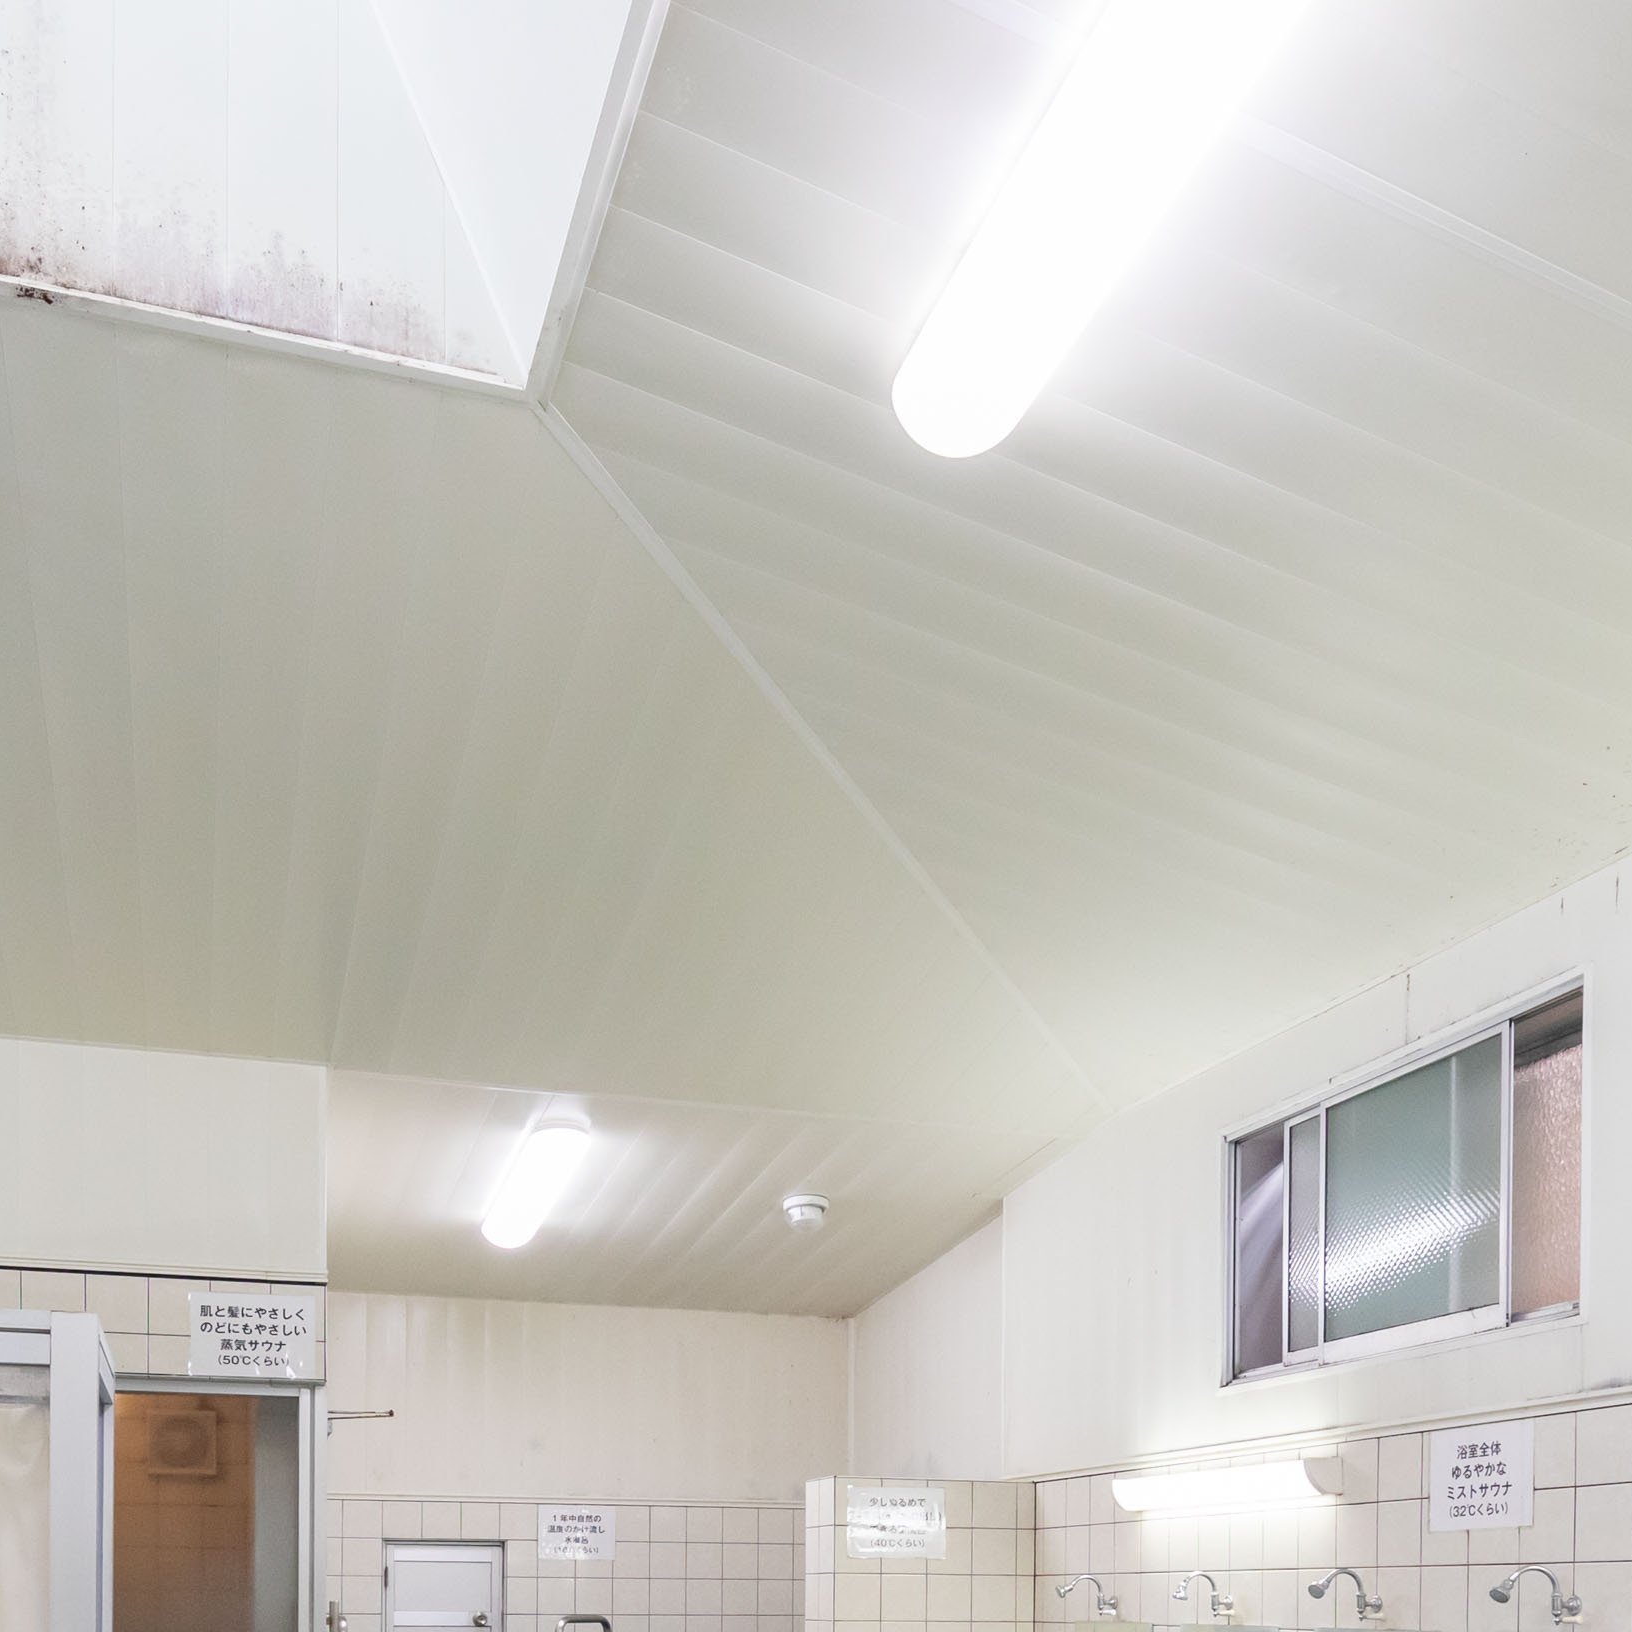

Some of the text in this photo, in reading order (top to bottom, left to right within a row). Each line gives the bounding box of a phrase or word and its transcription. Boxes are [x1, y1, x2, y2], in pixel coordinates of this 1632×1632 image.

[200, 1304, 305, 1321] 肌と髪にやさしく
[200, 1321, 307, 1336] のどにもやさしい
[220, 1338, 287, 1352] 蒸気サウナ
[1456, 1440, 1502, 1460] 浴室全体
[1451, 1461, 1507, 1480] ゆるやかな
[1447, 1481, 1513, 1500] ミストサウナ
[869, 1497, 927, 1508] 少しぬるめで
